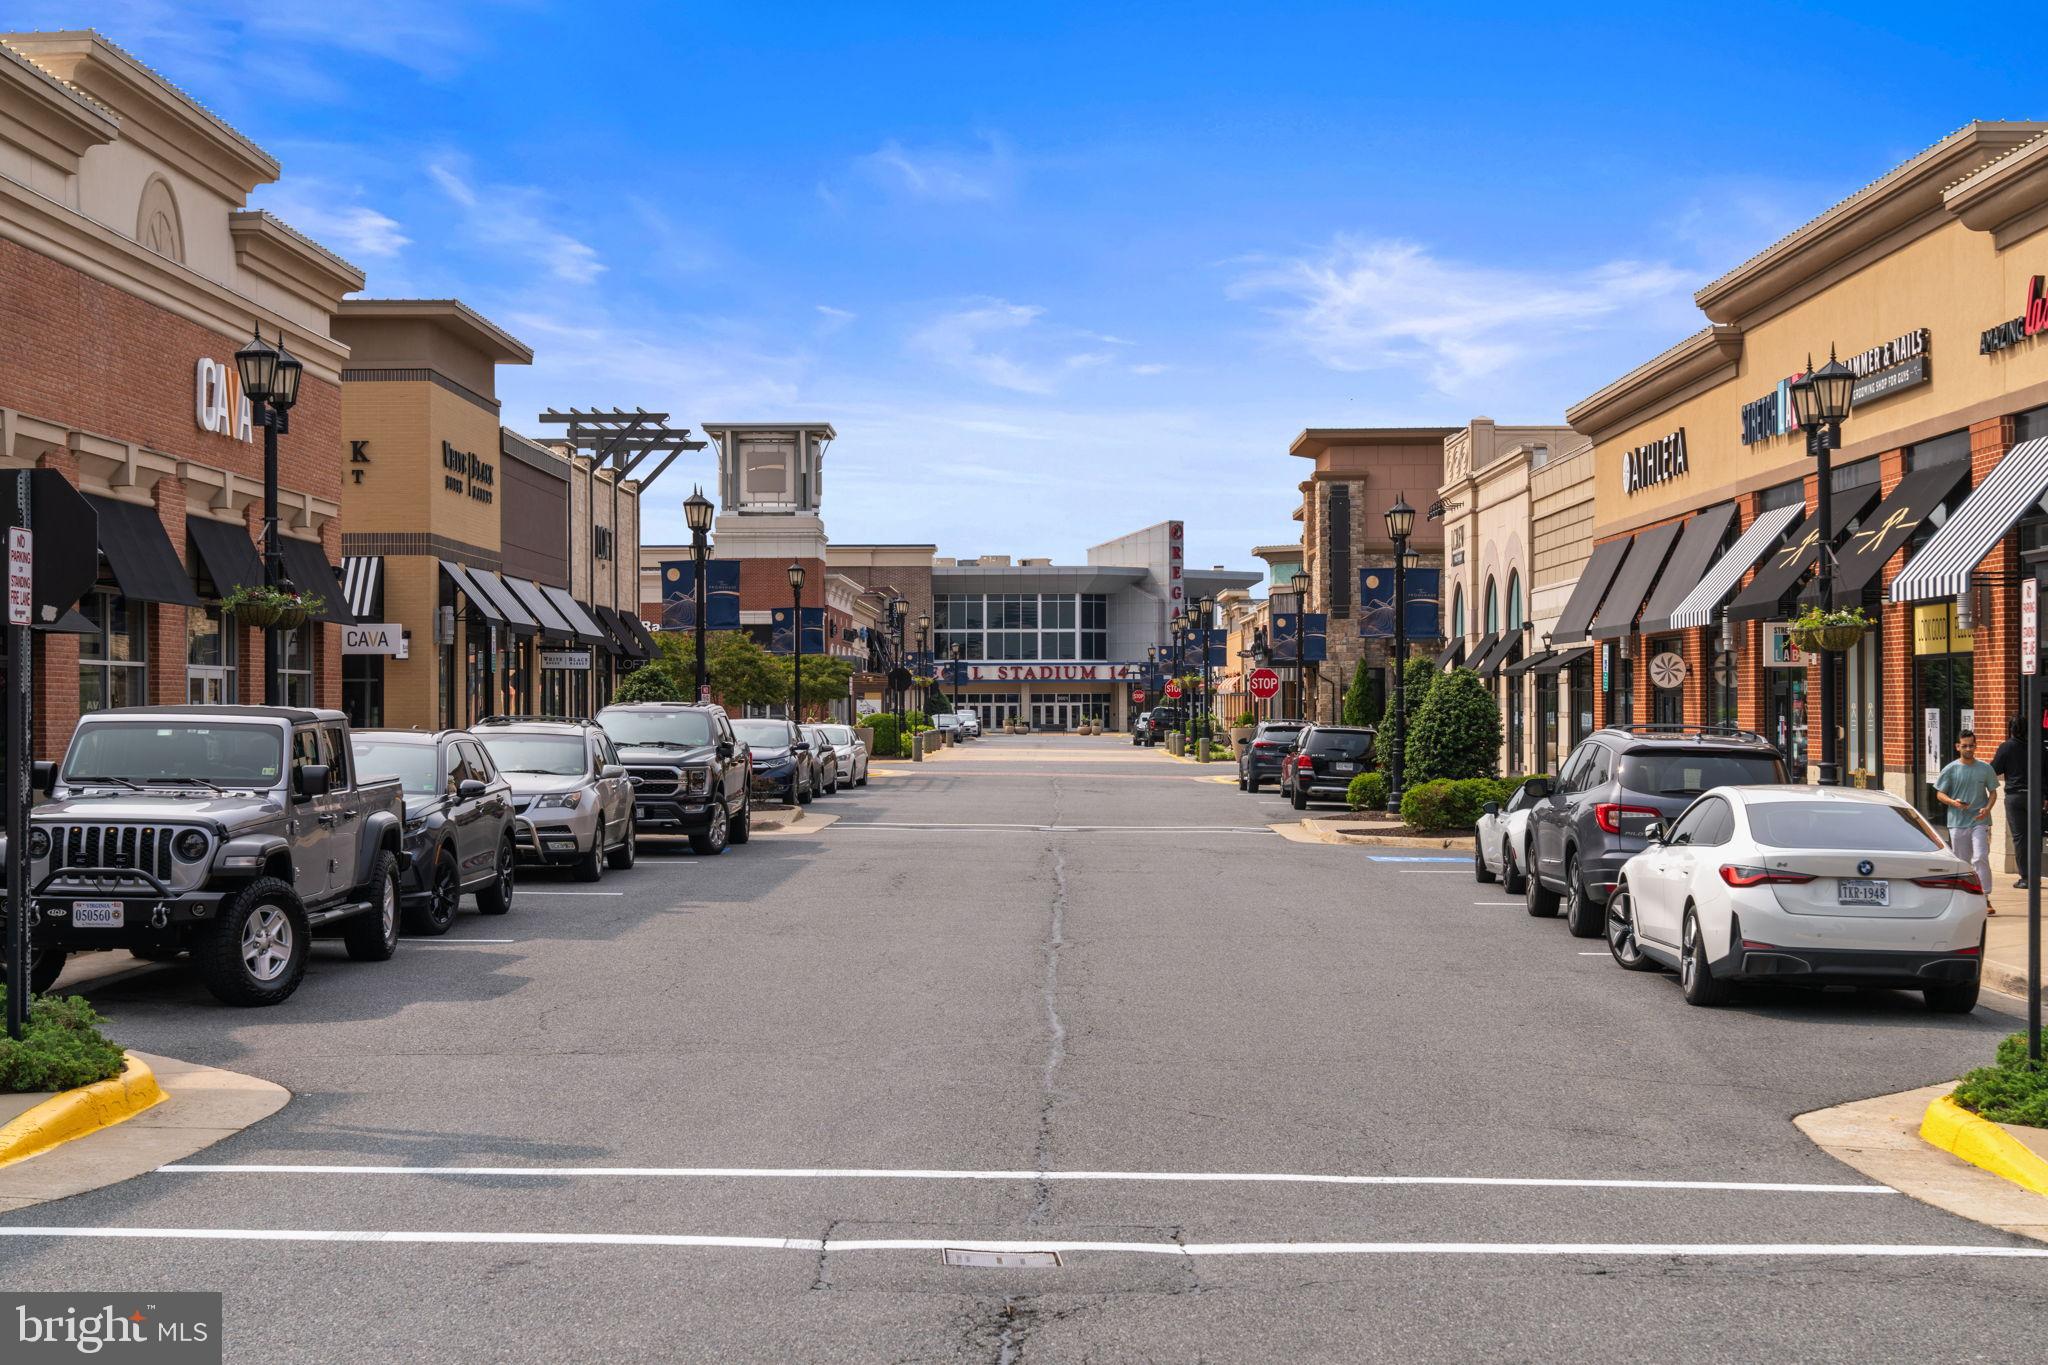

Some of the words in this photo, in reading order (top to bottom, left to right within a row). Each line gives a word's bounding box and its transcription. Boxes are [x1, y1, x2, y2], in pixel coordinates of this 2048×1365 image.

[1980, 316, 2024, 354] AMAZING
[1841, 347, 1880, 378] AMMER
[1883, 343, 1889, 366] &
[1893, 329, 1922, 363] NAILS
[1853, 382, 1875, 400] GROOMING
[1875, 377, 1887, 392] SHOP
[1888, 374, 1898, 387] FOR
[196, 357, 253, 443] CAVA
[1632, 427, 1688, 492] ATHLETA
[17, 534, 25, 548] NO
[11, 549, 31, 564] PARKING
[11, 575, 31, 589] STANDING
[1171, 546, 1182, 618] REGA
[11, 590, 19, 605] FIRE
[20, 592, 30, 607] LANE
[347, 631, 389, 647] CAVA
[1775, 649, 1800, 662] LAB
[616, 659, 648, 669] LOFT
[998, 667, 1096, 680] STADIUM
[1110, 666, 1129, 679] 14
[1166, 684, 1181, 693] STO
[1251, 677, 1278, 690] STOP
[75, 909, 111, 921] 050560
